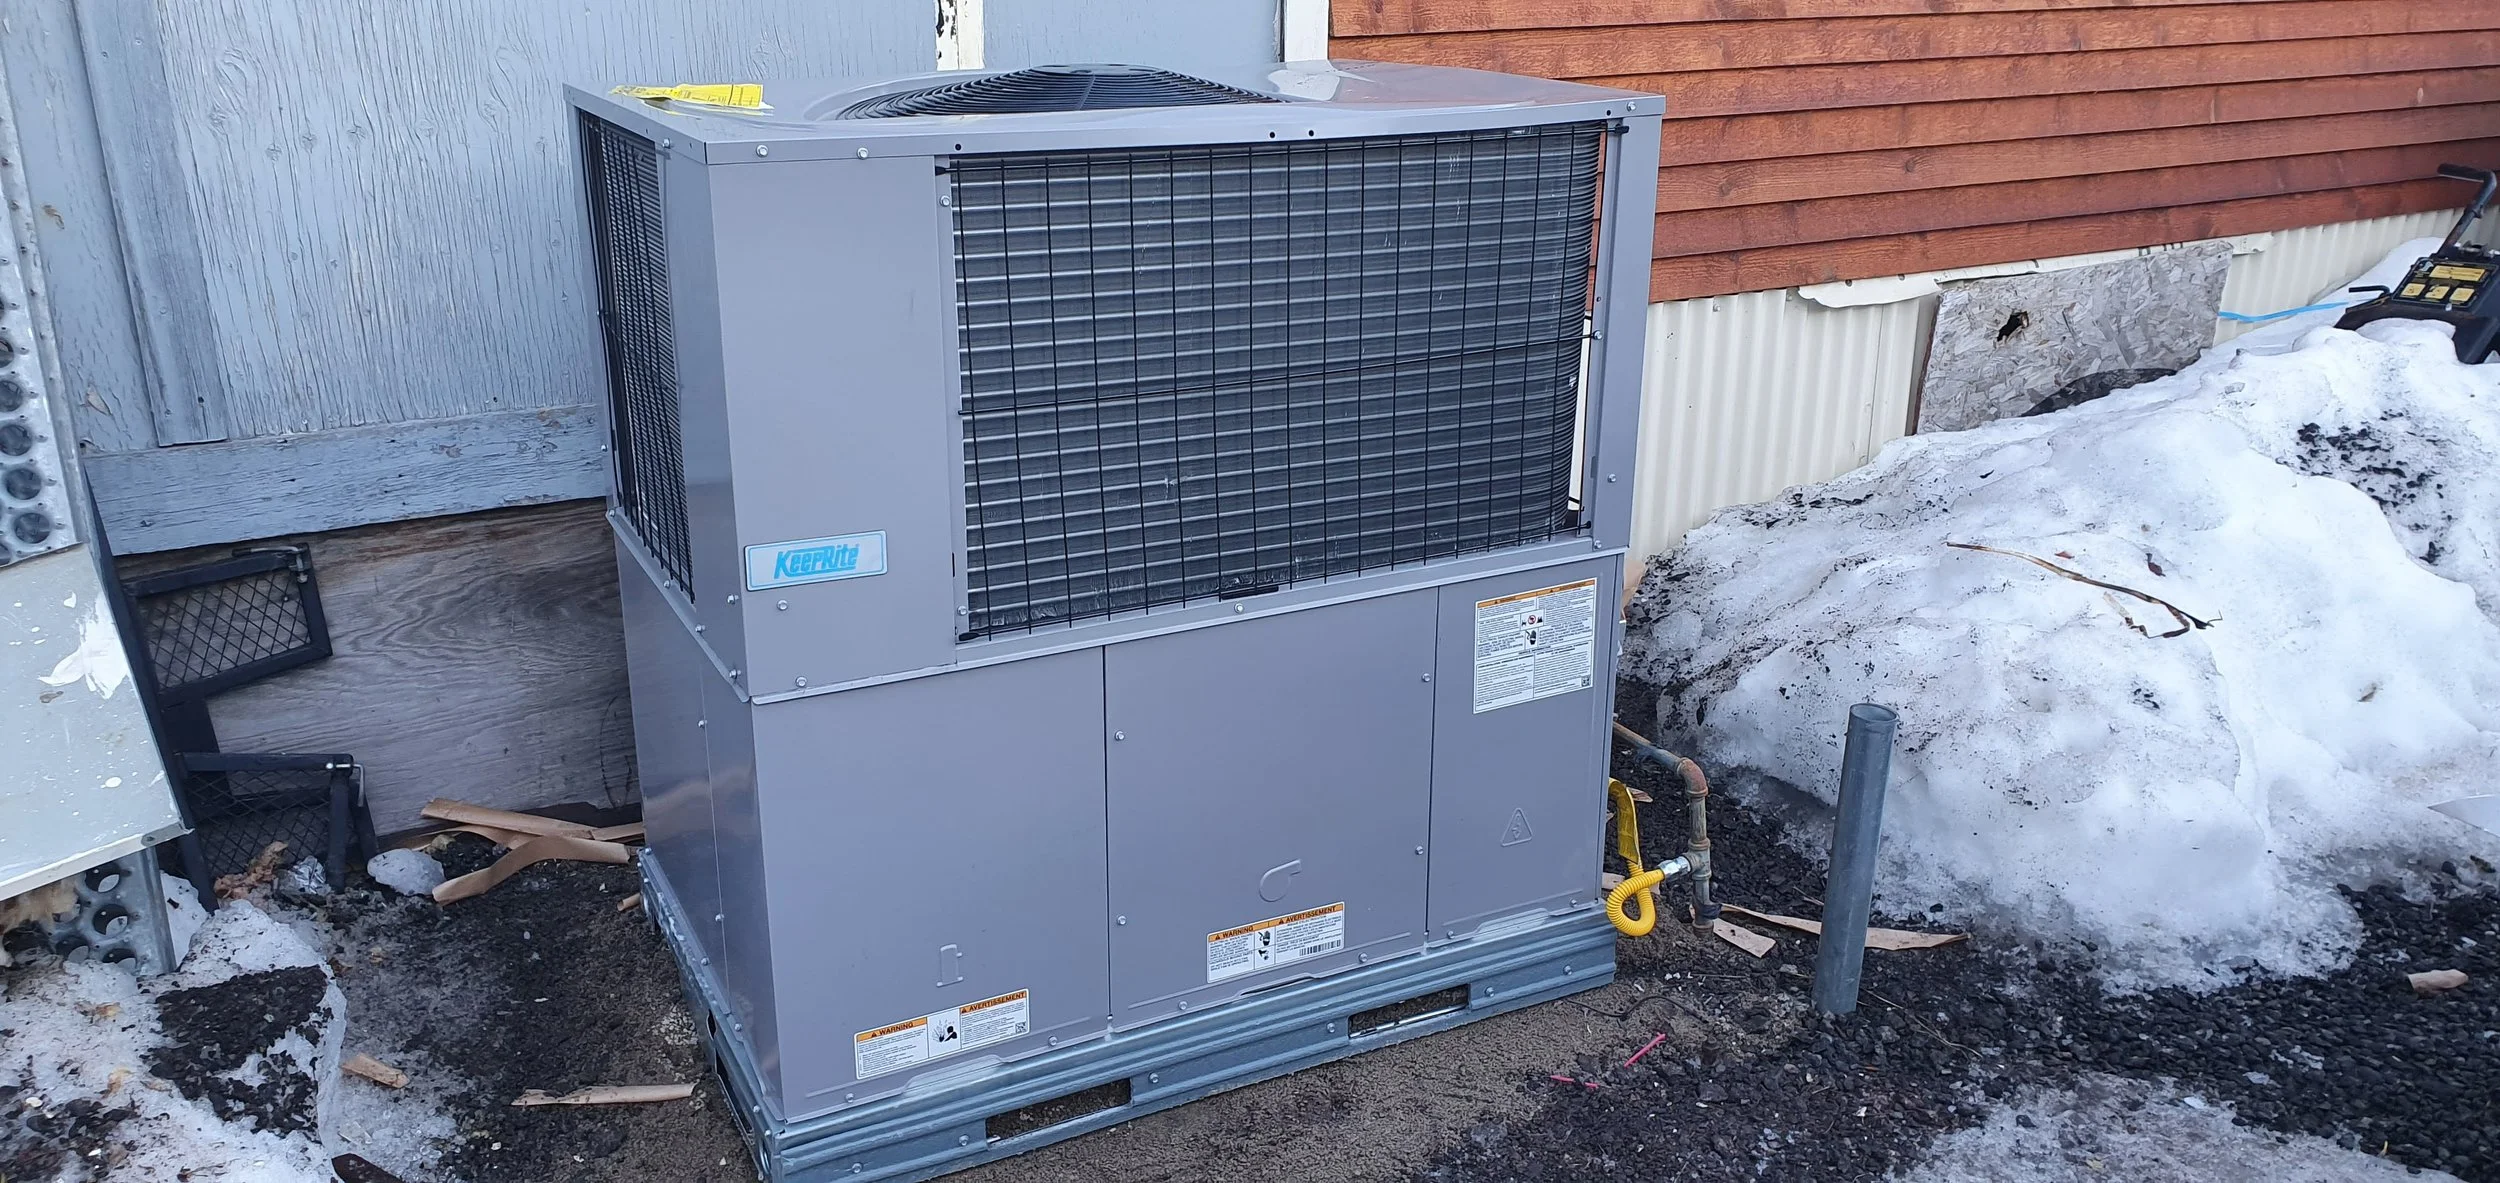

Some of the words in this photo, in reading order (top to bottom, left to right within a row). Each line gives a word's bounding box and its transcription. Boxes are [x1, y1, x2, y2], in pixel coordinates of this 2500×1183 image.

[774, 544, 859, 579] KeepRite
[1286, 905, 1336, 923] AVERTISSEMENT
[1222, 926, 1254, 939] WARNING
[969, 991, 1026, 1011] AVERTISSEMENT
[879, 1022, 914, 1036] WARNING
